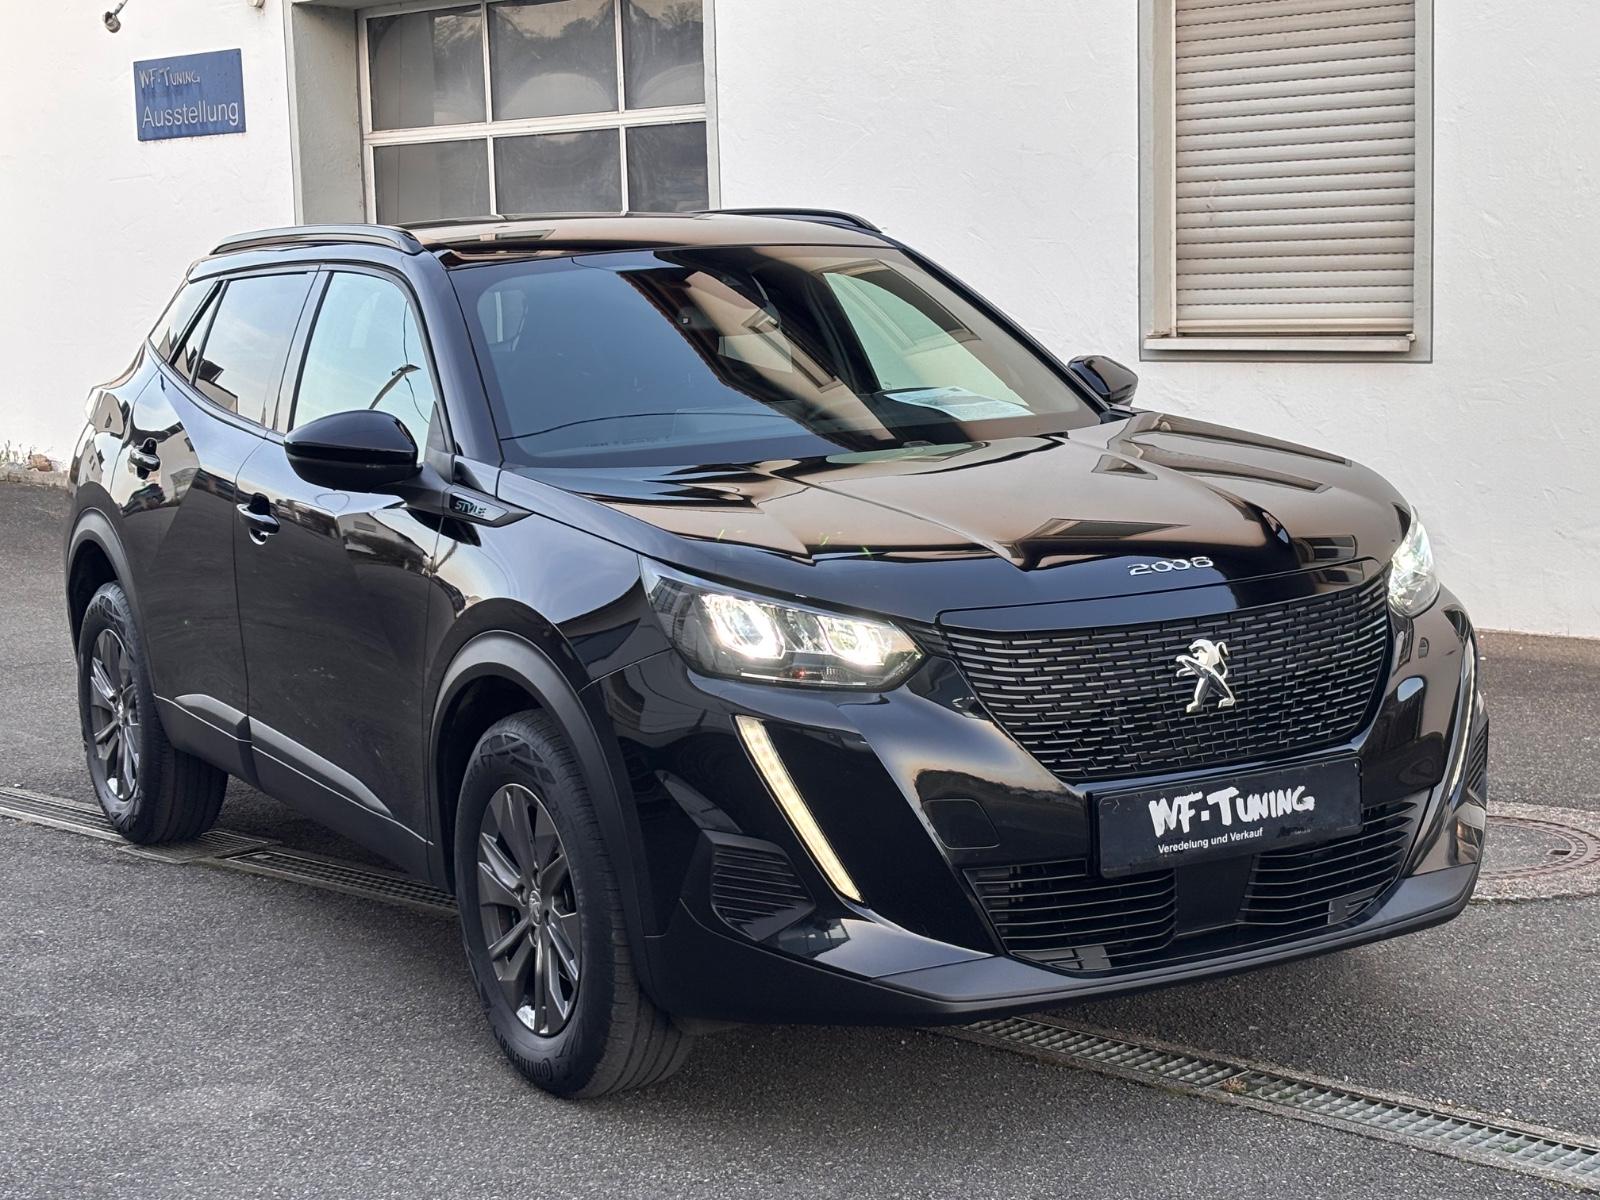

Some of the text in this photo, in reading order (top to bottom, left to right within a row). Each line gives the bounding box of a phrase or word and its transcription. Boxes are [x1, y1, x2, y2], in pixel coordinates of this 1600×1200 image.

[142, 99, 239, 128] Ausstellung
[454, 500, 487, 518] STYLE
[1127, 556, 1214, 576] 2008
[1158, 827, 1264, 854] Veredelung und Verkauf
